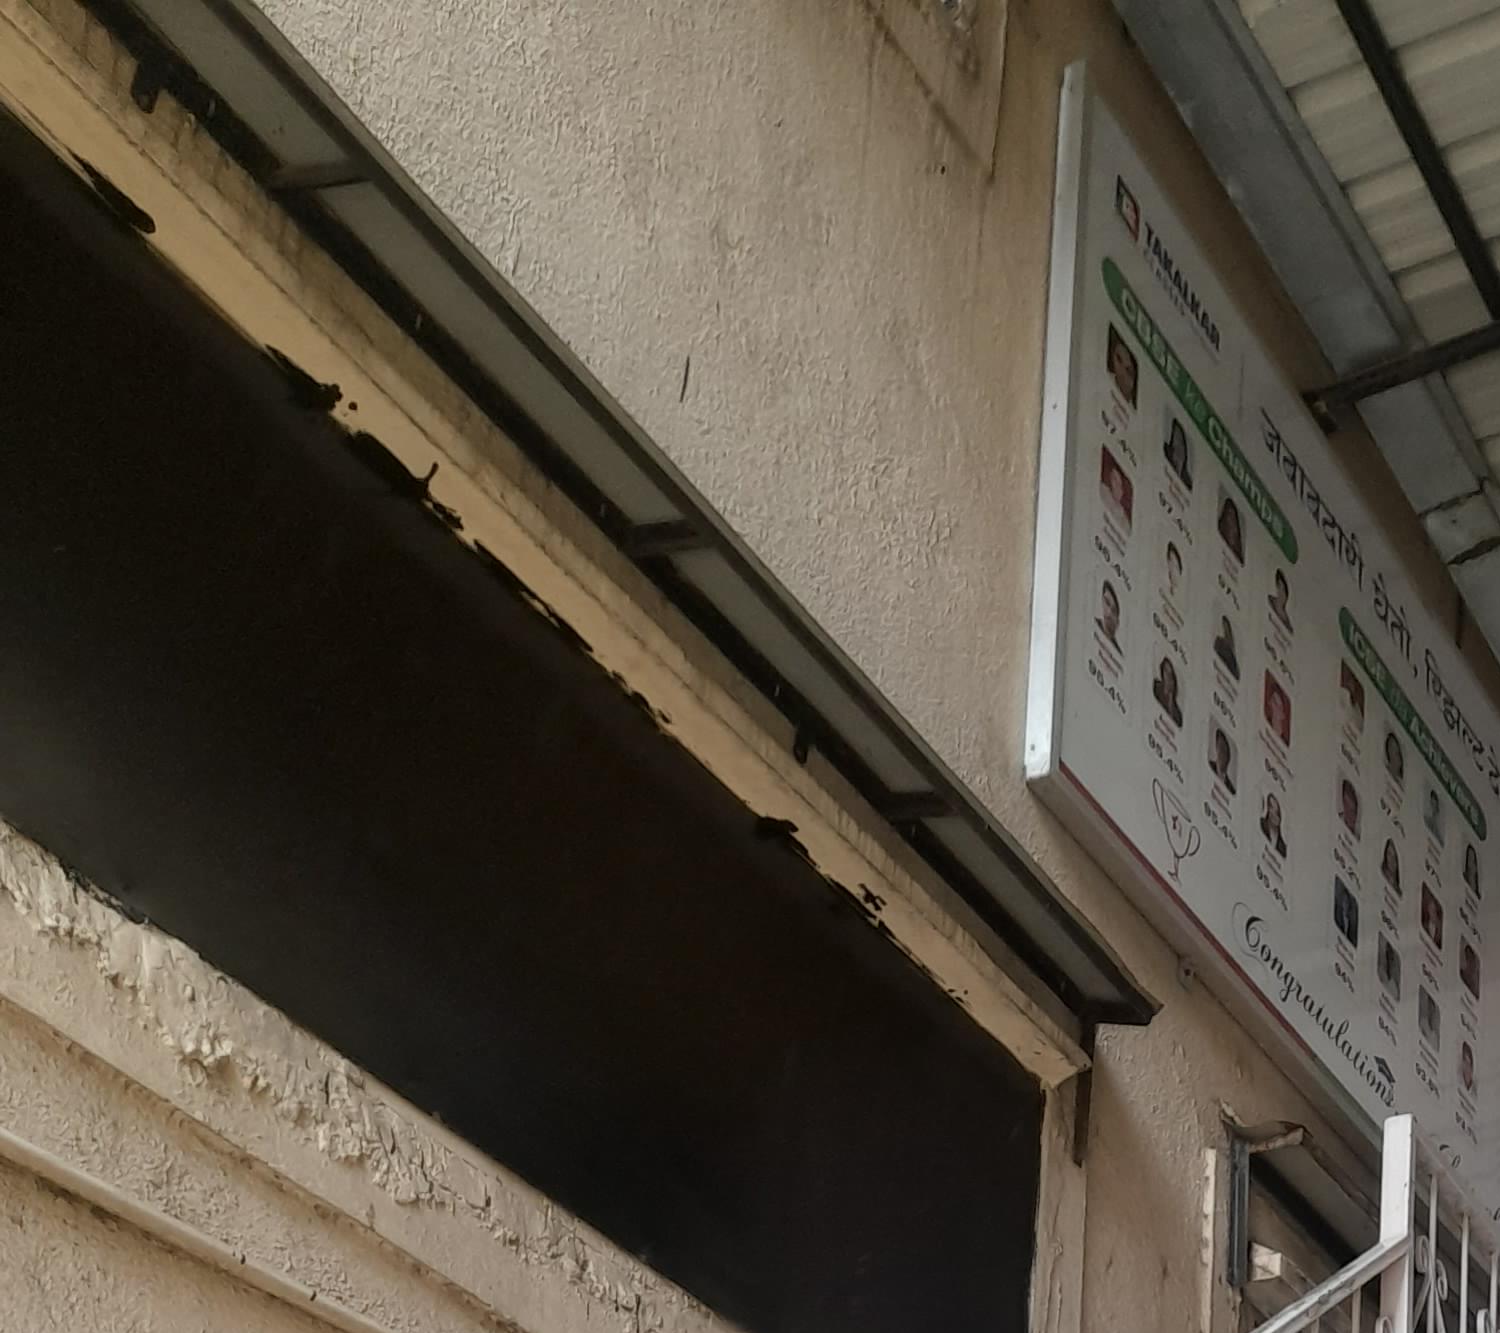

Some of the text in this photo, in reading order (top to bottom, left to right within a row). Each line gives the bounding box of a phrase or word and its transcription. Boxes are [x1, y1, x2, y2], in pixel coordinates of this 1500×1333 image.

[1121, 283, 1179, 391] CBSE
[1207, 410, 1283, 548] Champs
[1236, 906, 1396, 1108] Congratulations
